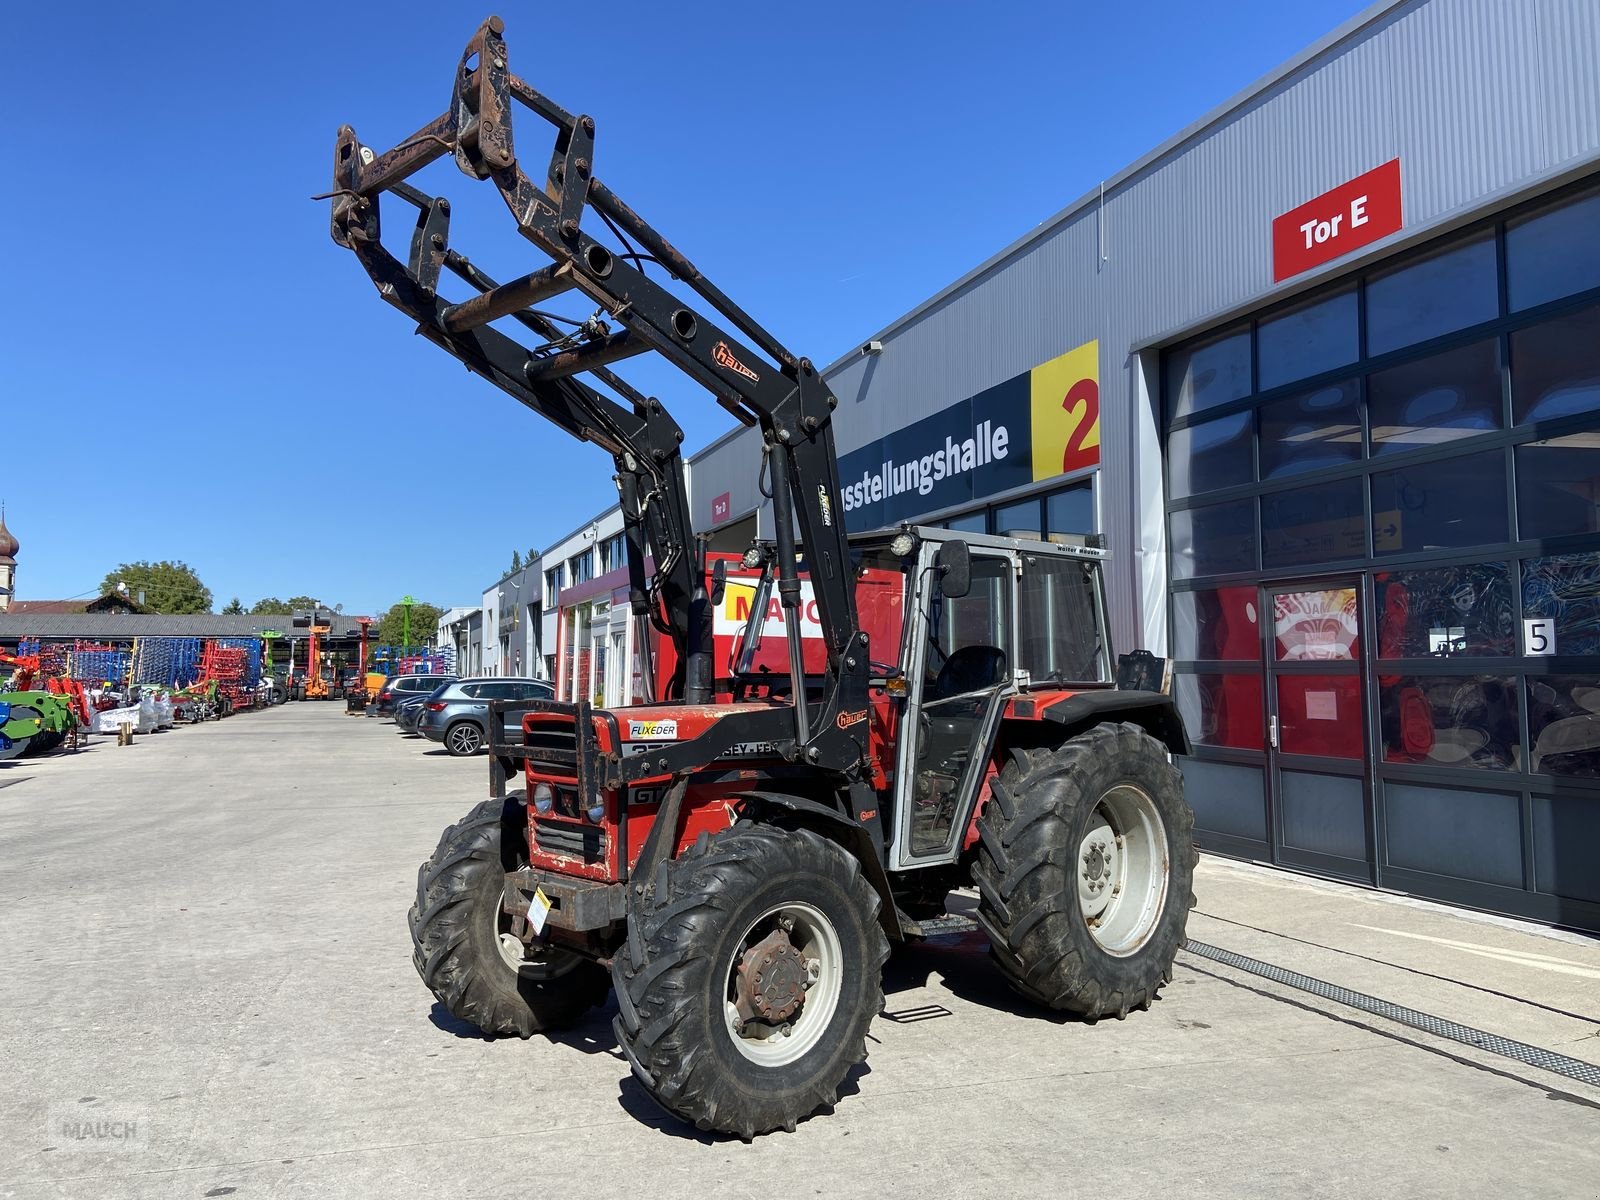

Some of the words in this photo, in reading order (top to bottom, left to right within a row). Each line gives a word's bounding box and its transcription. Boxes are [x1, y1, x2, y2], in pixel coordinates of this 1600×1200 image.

[1300, 214, 1343, 250] Tor
[1350, 195, 1369, 229] E
[841, 419, 1009, 512] sstellungshalle
[1061, 378, 1100, 473] 2
[736, 597, 822, 624] MAC
[1531, 623, 1548, 652] 5
[631, 726, 675, 736] FLIXEDER
